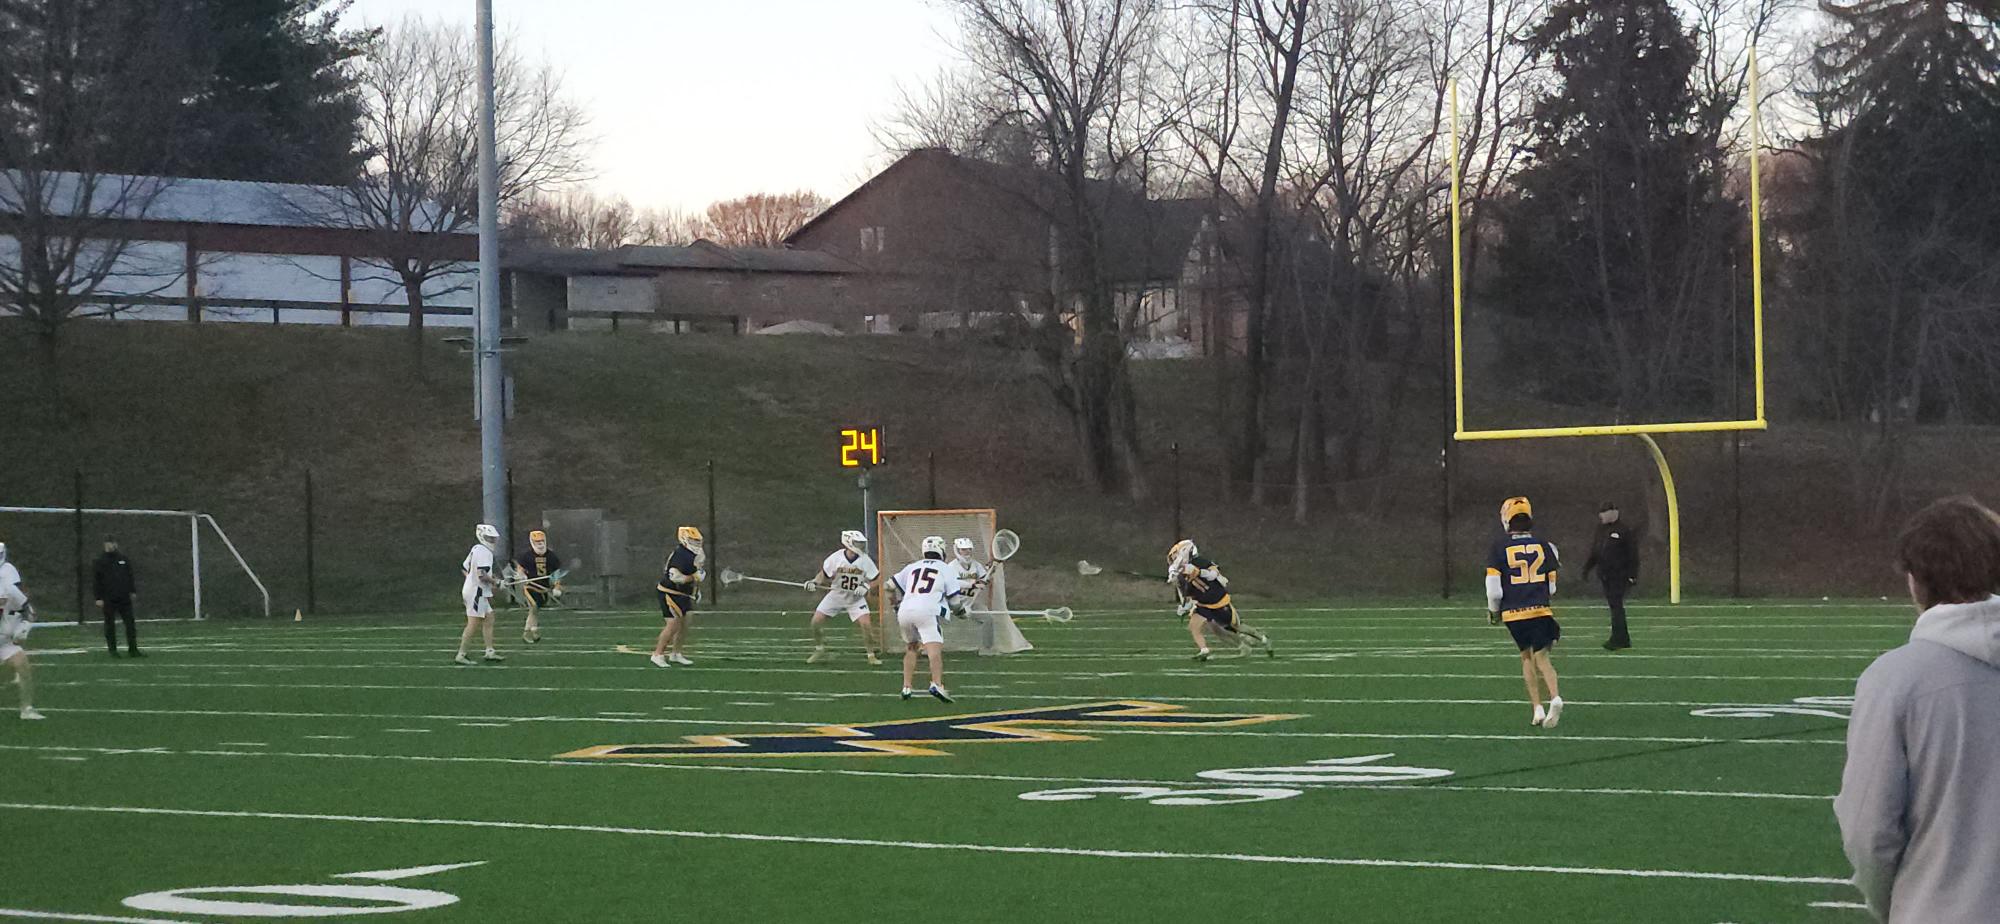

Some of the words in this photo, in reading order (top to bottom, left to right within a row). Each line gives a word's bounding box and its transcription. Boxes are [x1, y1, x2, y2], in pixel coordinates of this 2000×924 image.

[841, 429, 877, 466] 24
[841, 575, 858, 591] 26
[911, 567, 938, 594] 15
[1505, 544, 1546, 585] 52
[1018, 766, 1455, 805] 30
